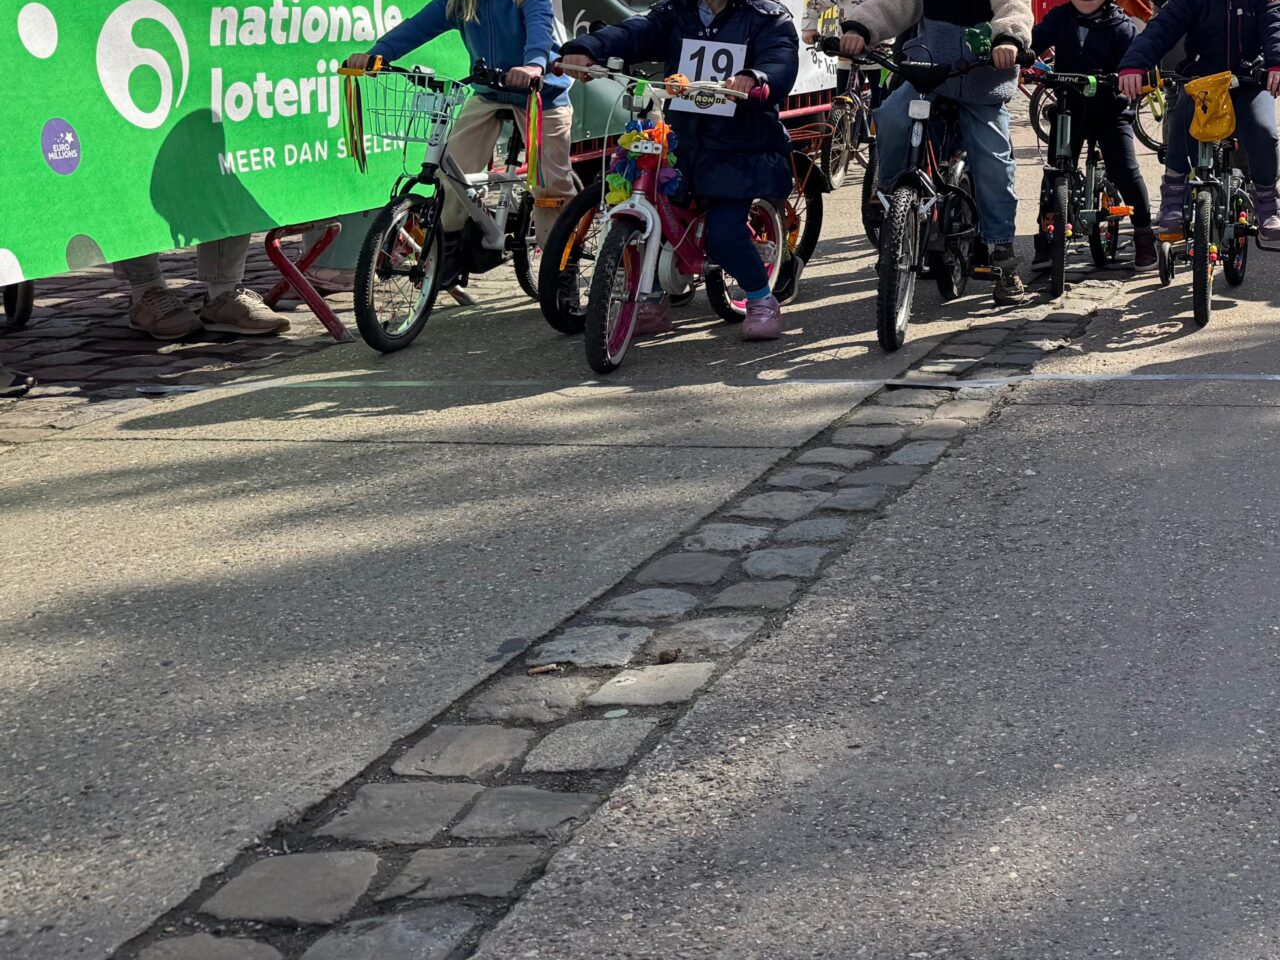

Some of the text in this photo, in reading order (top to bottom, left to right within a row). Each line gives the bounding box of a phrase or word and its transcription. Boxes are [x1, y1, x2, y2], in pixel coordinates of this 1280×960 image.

[689, 45, 734, 82] 19
[211, 58, 341, 128] loterij
[48, 149, 78, 160] MILLIONS
[52, 143, 71, 152] EURO
[218, 129, 405, 176] MEER DAN SELEN
